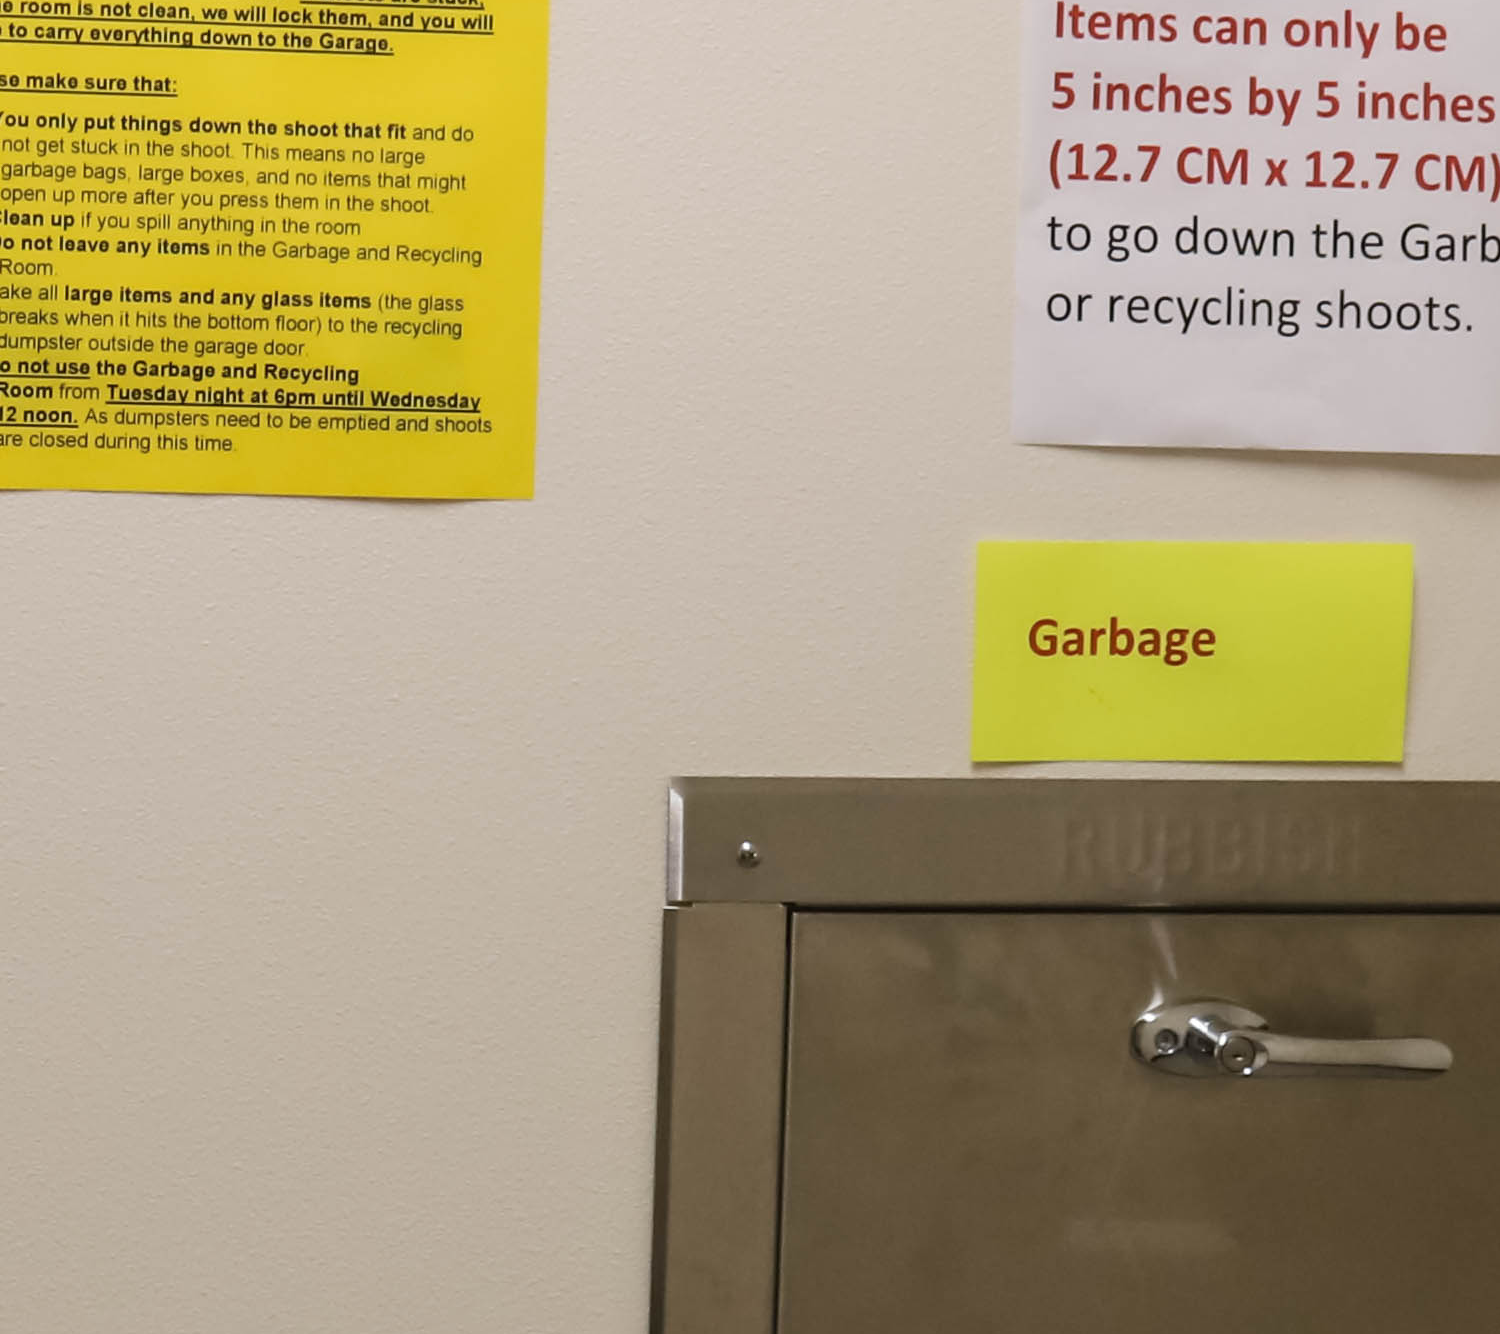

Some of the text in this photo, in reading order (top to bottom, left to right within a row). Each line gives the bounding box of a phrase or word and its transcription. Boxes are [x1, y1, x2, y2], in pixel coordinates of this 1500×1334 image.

[7, 21, 28, 38] to
[33, 25, 84, 43] carry
[88, 25, 194, 46] everything
[199, 28, 252, 47] down
[256, 30, 277, 47] to
[281, 30, 313, 49] the
[318, 31, 393, 52] Garage.
[1054, 0, 1447, 57] Items can only be
[25, 71, 78, 90] make
[83, 76, 127, 91] sure
[132, 74, 177, 93] that:
[1050, 70, 1496, 124] 5 inches by 5 inches
[35, 111, 78, 133] only
[83, 114, 116, 134] put
[119, 113, 183, 137] things
[188, 115, 242, 135] down
[246, 118, 278, 136] the
[283, 119, 339, 138] shoot
[343, 121, 382, 139] that
[386, 122, 407, 140] fit
[411, 124, 446, 141] and
[450, 125, 474, 143] do
[1048, 137, 1161, 190] (12.7
[1175, 145, 1249, 186] CM
[1263, 157, 1288, 187] x
[1304, 149, 1399, 190] 12.7
[20, 234, 53, 251] not
[58, 234, 110, 253] leave
[115, 239, 152, 258] any
[156, 237, 210, 256] items
[215, 242, 232, 256] in
[237, 240, 266, 257] the
[271, 240, 350, 264] Garbage
[355, 244, 390, 261] and
[395, 244, 482, 267] Recycling
[1046, 215, 1091, 252] to
[1106, 223, 1158, 263] go
[1174, 214, 1295, 258] down
[1310, 217, 1384, 260] the
[1045, 286, 1472, 338] or recycling shoots.
[16, 358, 50, 374] not
[54, 361, 90, 375] use
[95, 358, 127, 376] the
[131, 358, 216, 382] Garbage
[220, 362, 257, 379] and
[263, 362, 359, 386] Recycling
[58, 382, 100, 400] from
[105, 382, 189, 404] Tuesday
[194, 385, 244, 405] night
[249, 387, 268, 404] at
[273, 387, 316, 406] 6pm
[321, 389, 364, 407] until
[369, 389, 481, 411] Wednesday
[1027, 615, 1216, 667] Garbage
